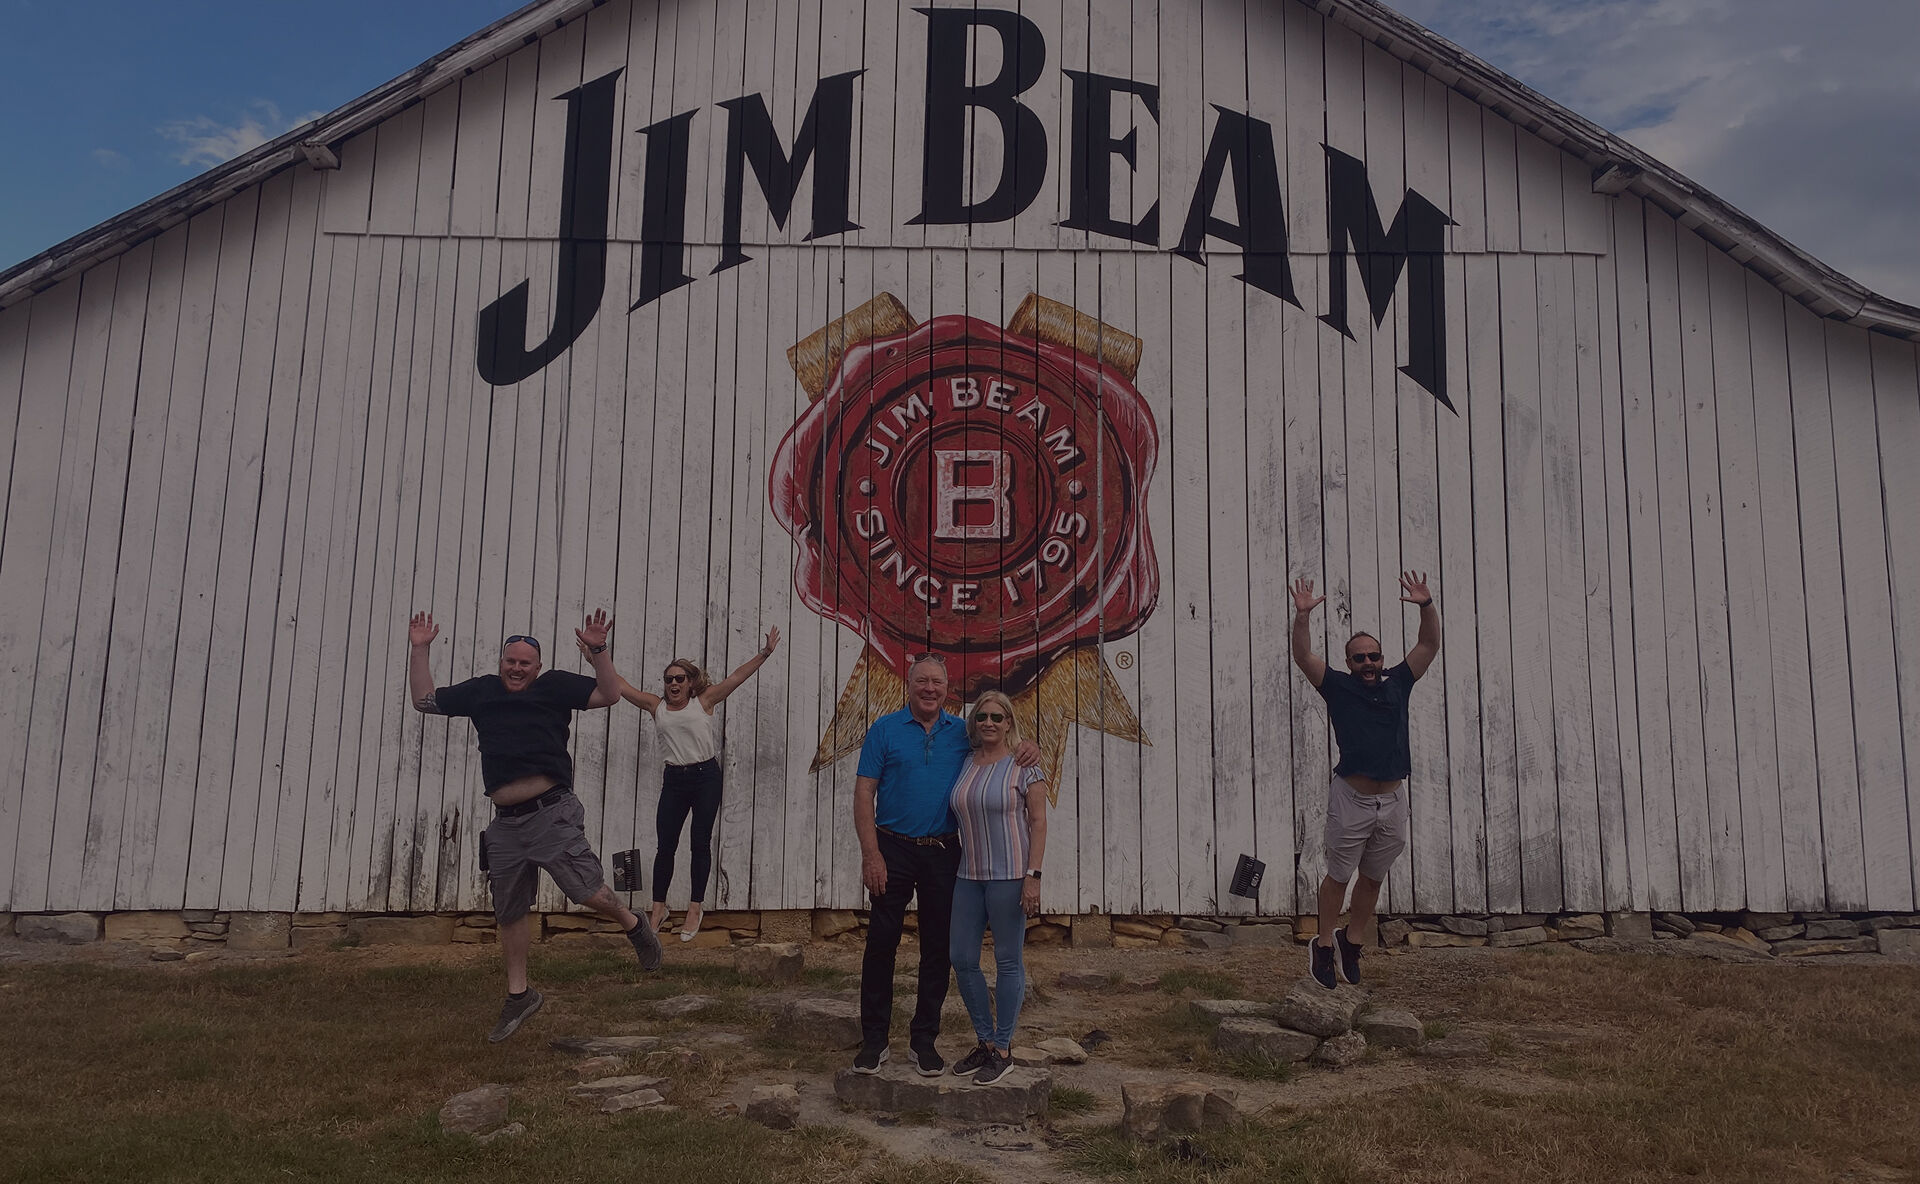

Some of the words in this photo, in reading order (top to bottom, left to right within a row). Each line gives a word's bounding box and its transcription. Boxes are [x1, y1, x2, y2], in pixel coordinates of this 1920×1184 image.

[477, 66, 868, 386] JIM
[904, 8, 1460, 418] BEAM
[864, 392, 932, 466] JIM
[949, 377, 1080, 466] BEAM
[934, 450, 1011, 539] B
[855, 507, 978, 611] SINCE
[1002, 509, 1088, 602] 1795
